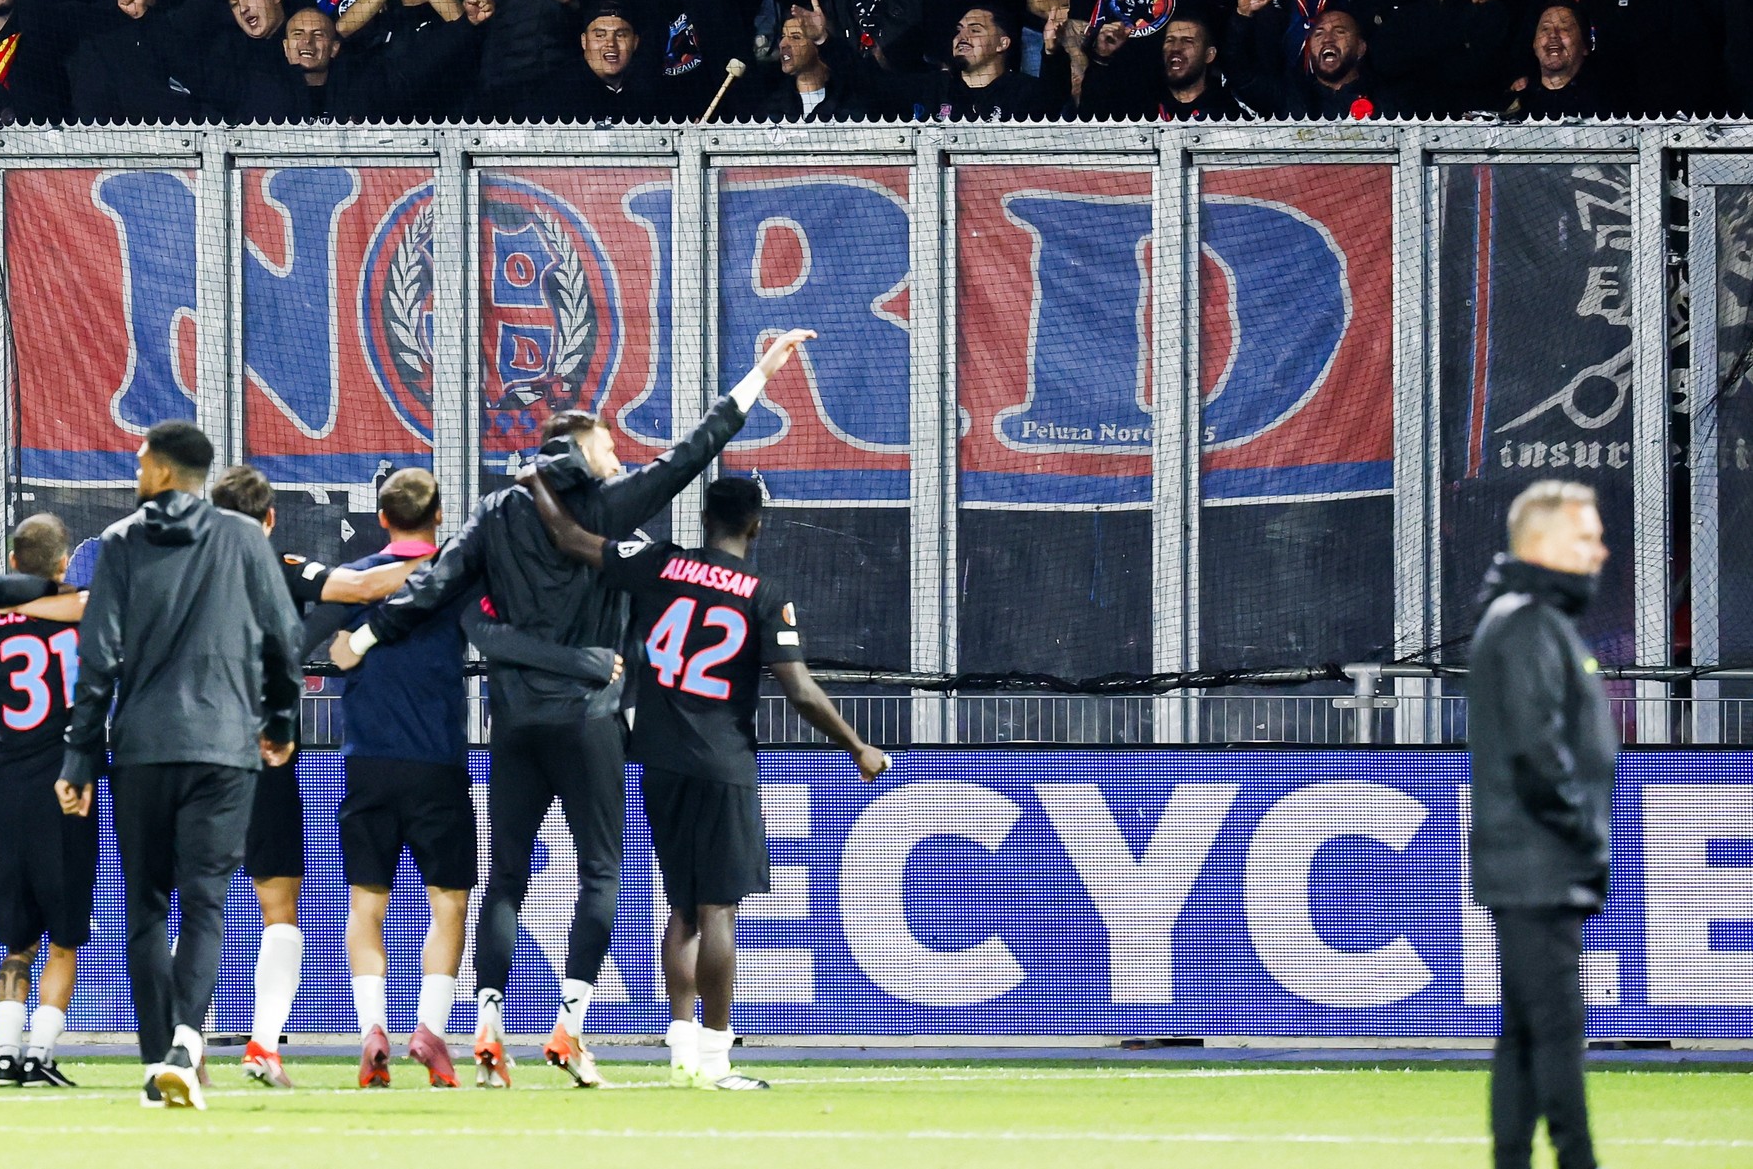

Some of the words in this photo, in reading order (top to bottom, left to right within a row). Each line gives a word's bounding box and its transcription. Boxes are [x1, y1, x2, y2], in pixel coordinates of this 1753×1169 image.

[659, 556, 760, 600] ALHASSAN
[0, 627, 81, 732] 31
[646, 595, 749, 700] 42
